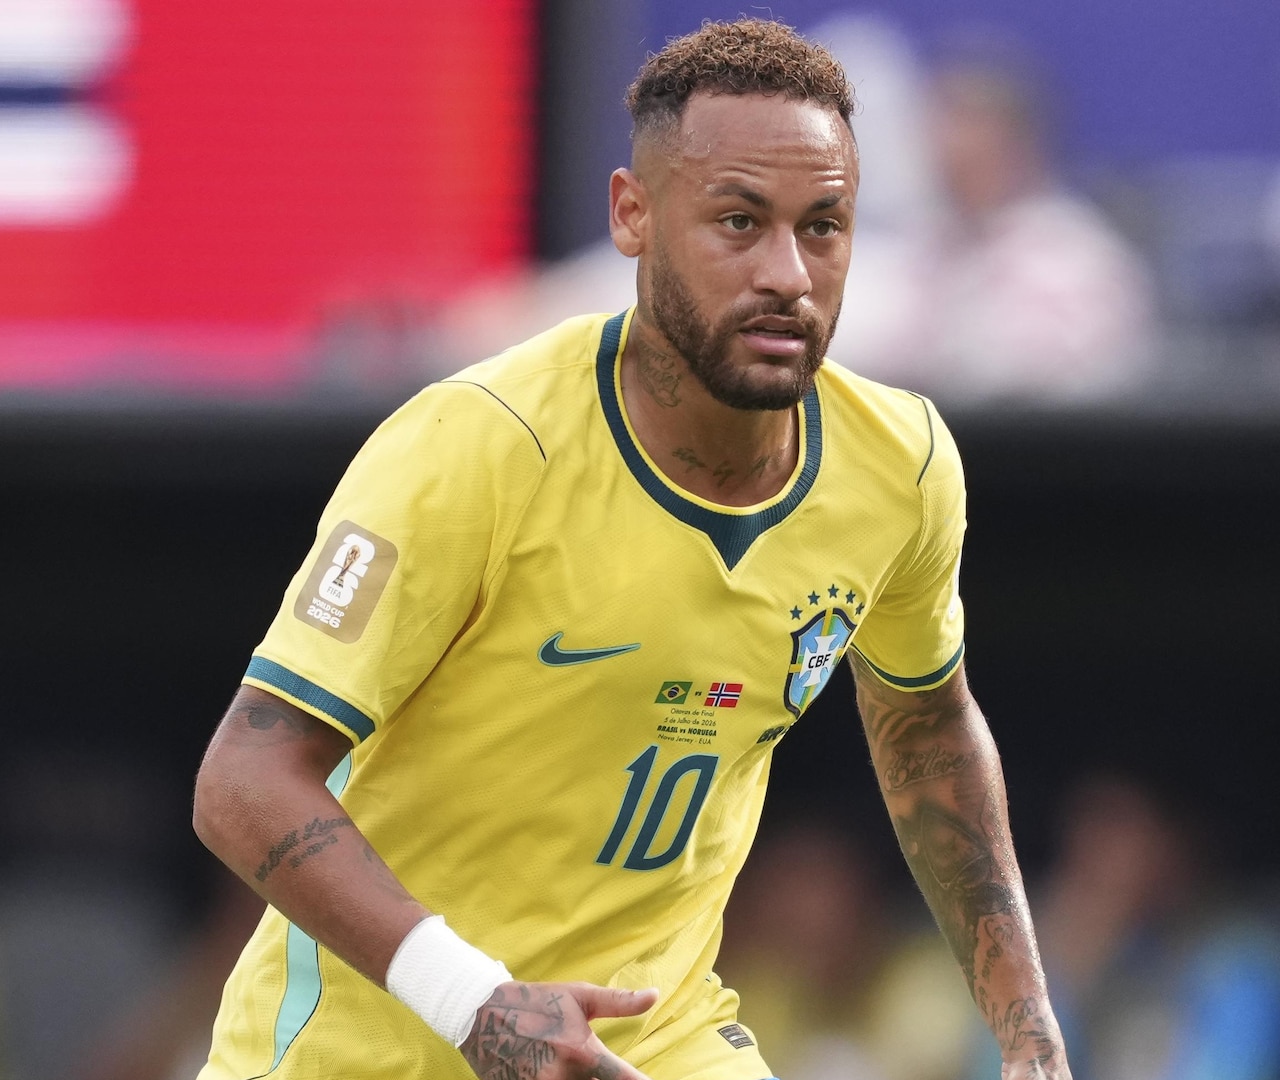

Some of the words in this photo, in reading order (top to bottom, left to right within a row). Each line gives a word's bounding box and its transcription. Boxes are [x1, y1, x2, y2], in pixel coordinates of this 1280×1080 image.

[326, 586, 342, 599] FIFA
[312, 597, 331, 612] WORLD
[330, 607, 345, 618] CUP
[306, 605, 342, 629] 2026
[808, 653, 832, 669] CBF
[701, 719, 717, 727] 2026
[656, 725, 678, 733] BRASIL
[688, 728, 717, 737] NORUEGA
[676, 736, 694, 744] Jersey
[698, 737, 712, 745] EUA
[594, 744, 720, 873] 10
